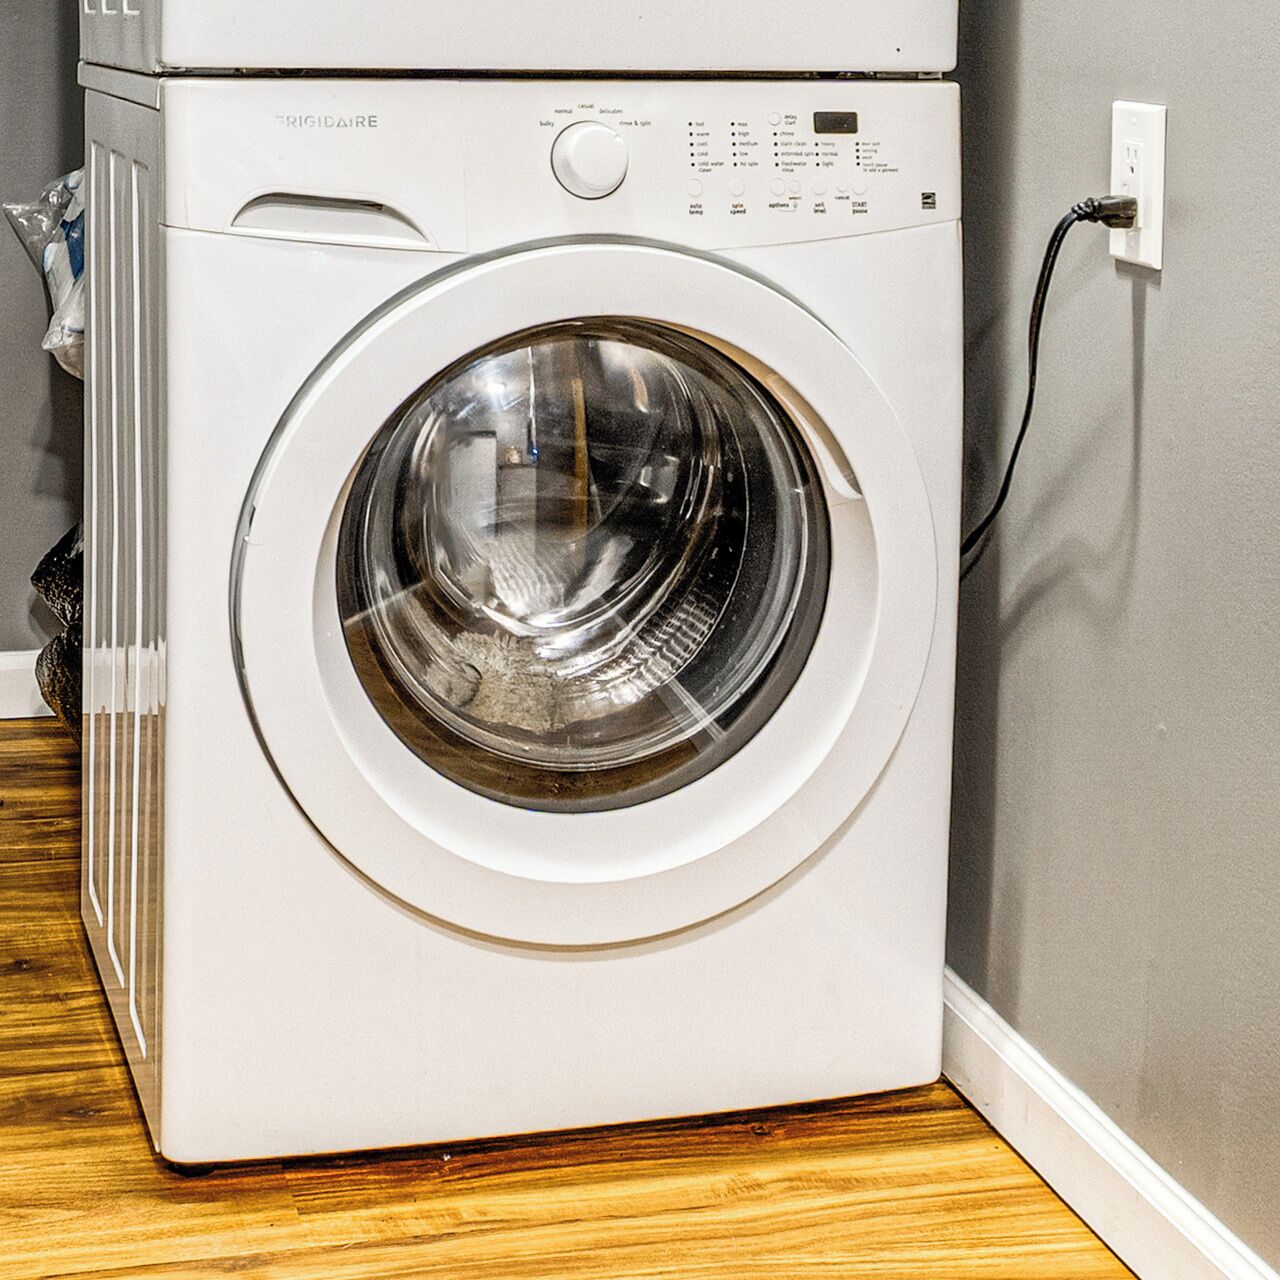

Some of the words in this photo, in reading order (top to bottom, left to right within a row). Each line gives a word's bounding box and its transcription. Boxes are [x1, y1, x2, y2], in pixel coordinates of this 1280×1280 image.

[275, 115, 379, 129] FRIGIDAIRE
[539, 119, 555, 128] bulky
[730, 207, 747, 216] speed
